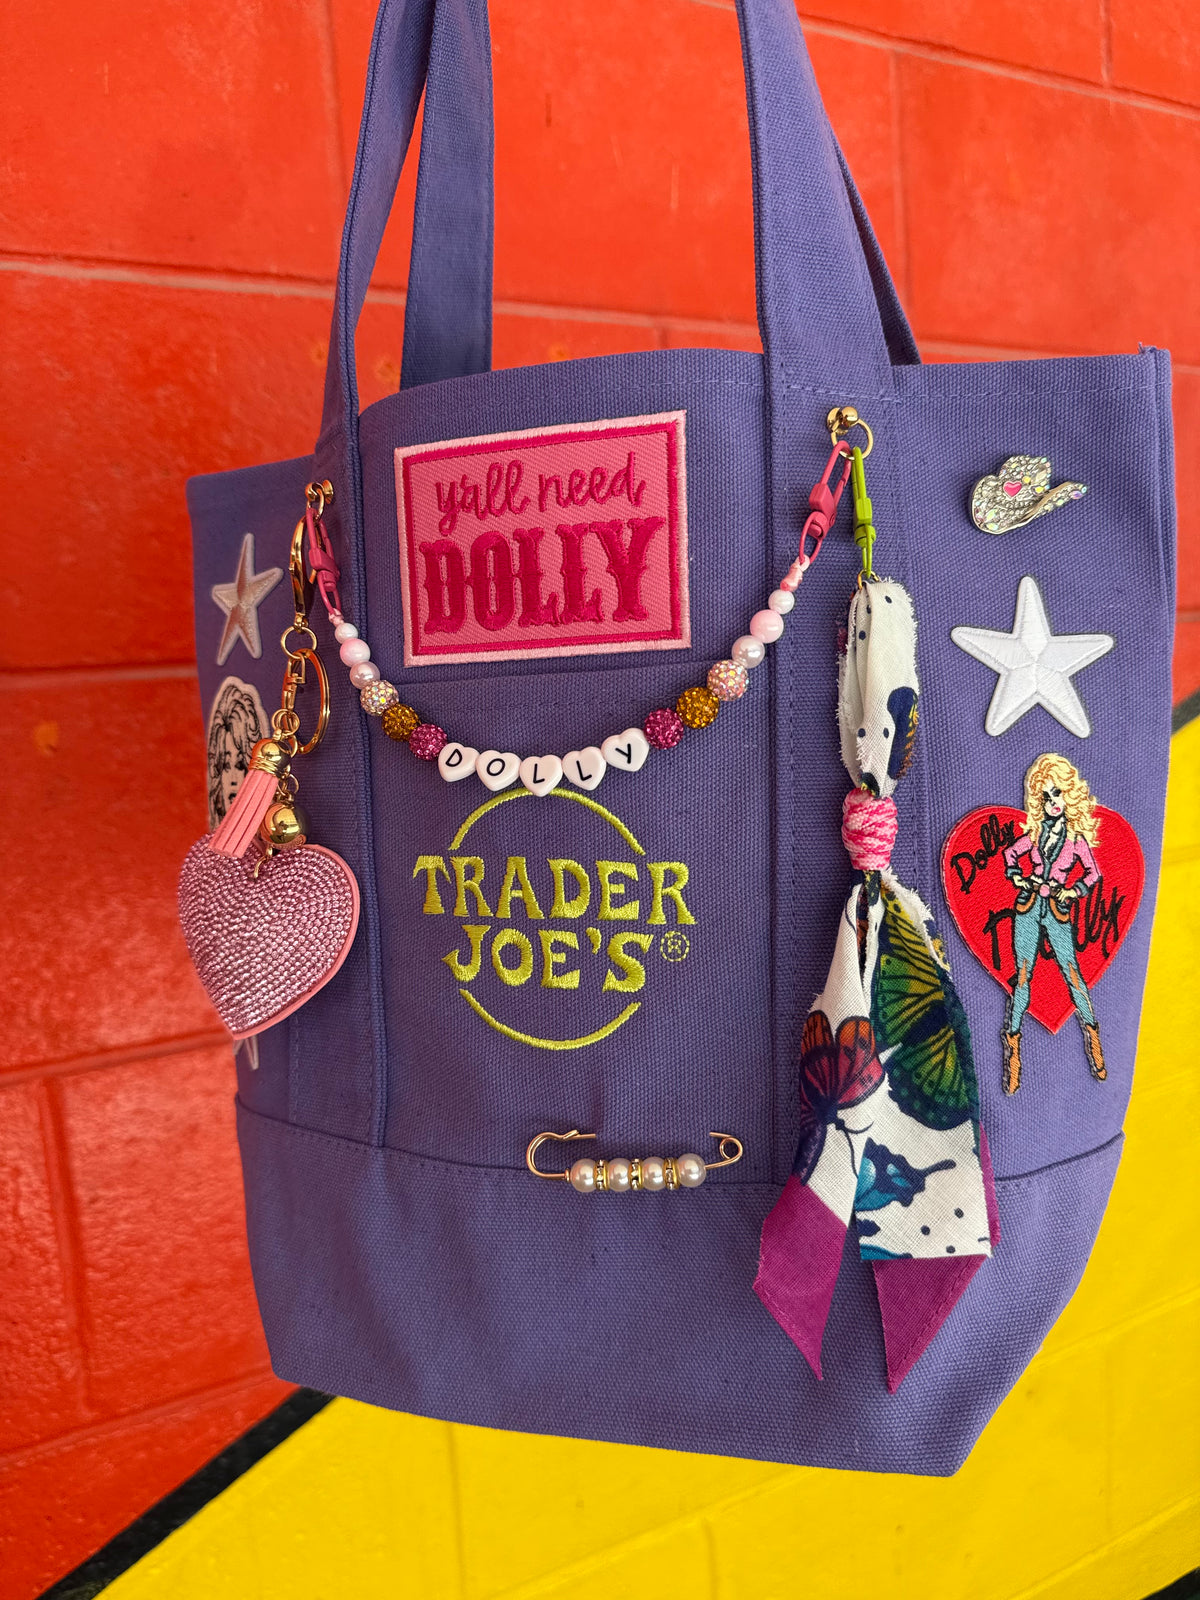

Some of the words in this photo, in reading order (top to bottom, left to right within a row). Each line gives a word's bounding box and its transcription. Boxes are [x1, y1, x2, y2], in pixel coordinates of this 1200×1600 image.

[435, 459, 531, 536] y'all
[538, 451, 647, 513] need
[418, 516, 667, 635] DOLLY
[444, 742, 633, 785] DOLLY
[412, 855, 698, 925] TRADER
[951, 813, 1016, 895] Dolly
